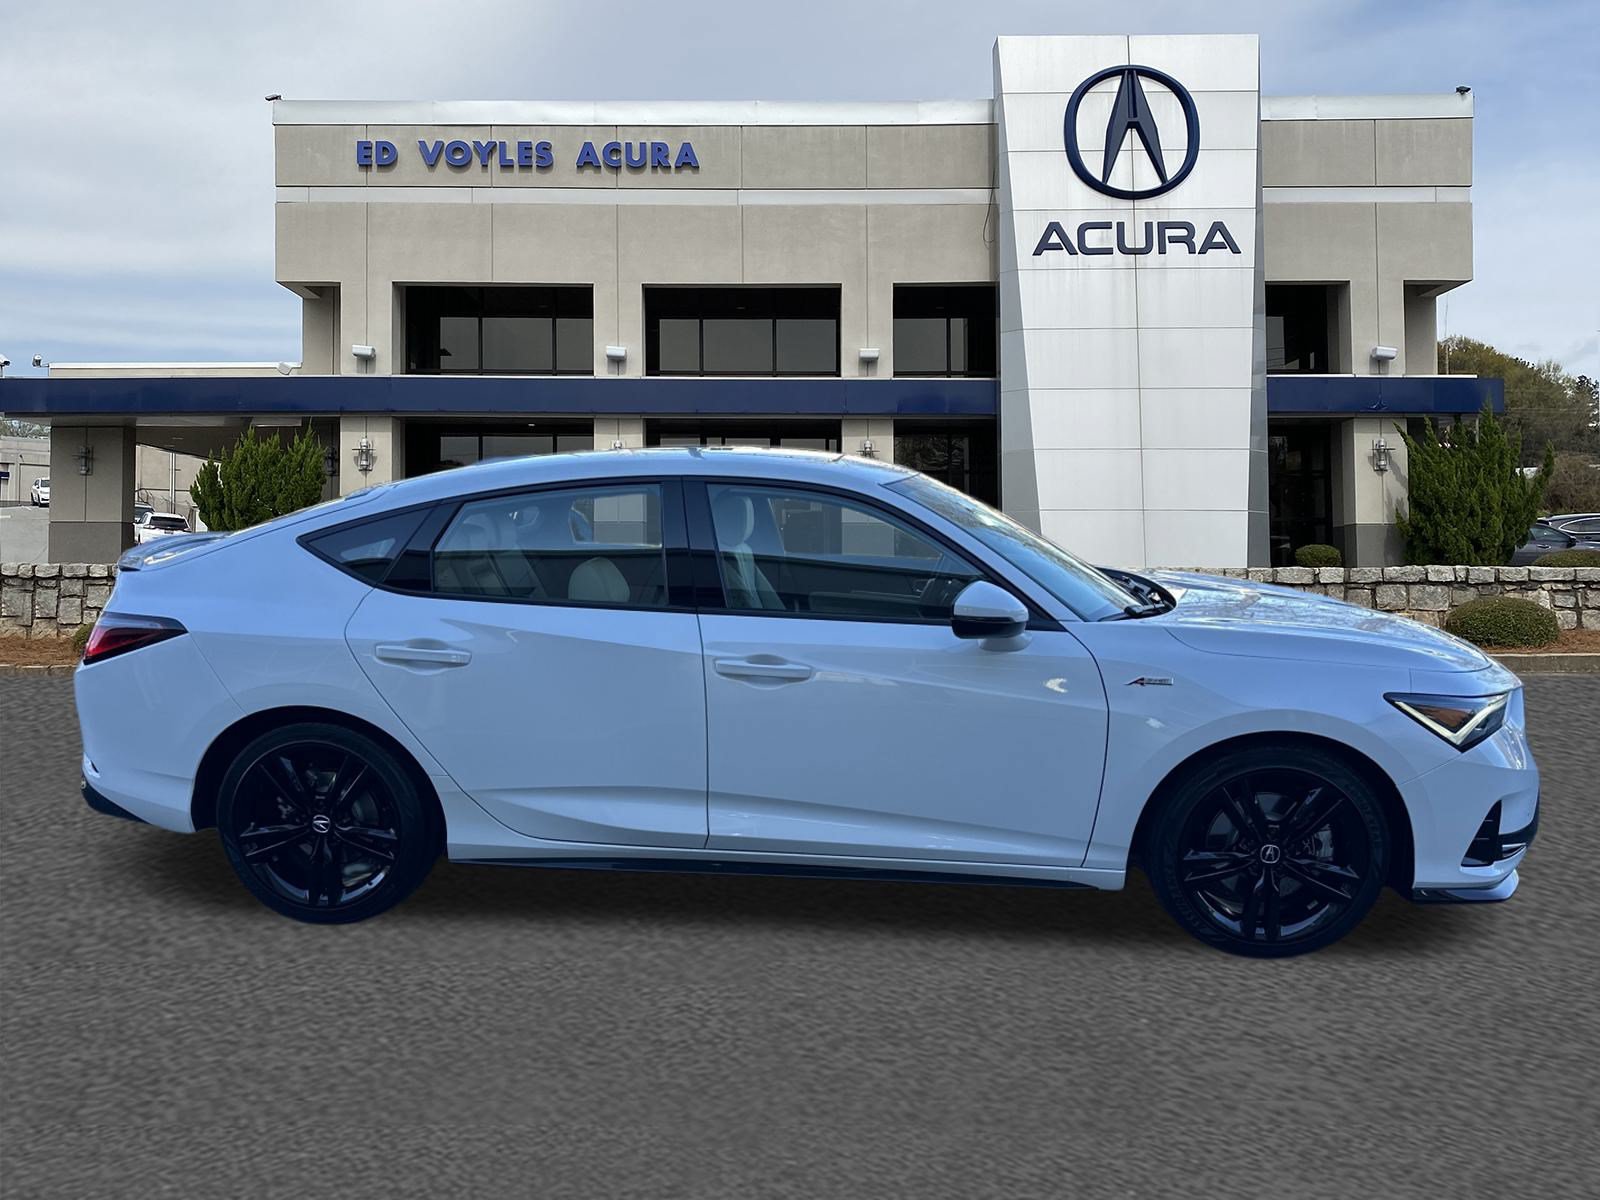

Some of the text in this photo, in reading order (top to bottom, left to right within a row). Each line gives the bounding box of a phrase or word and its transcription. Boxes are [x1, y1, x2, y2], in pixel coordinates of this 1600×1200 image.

[356, 140, 700, 168] ED VOYLES ACURA
[1032, 221, 1242, 256] ACURA
